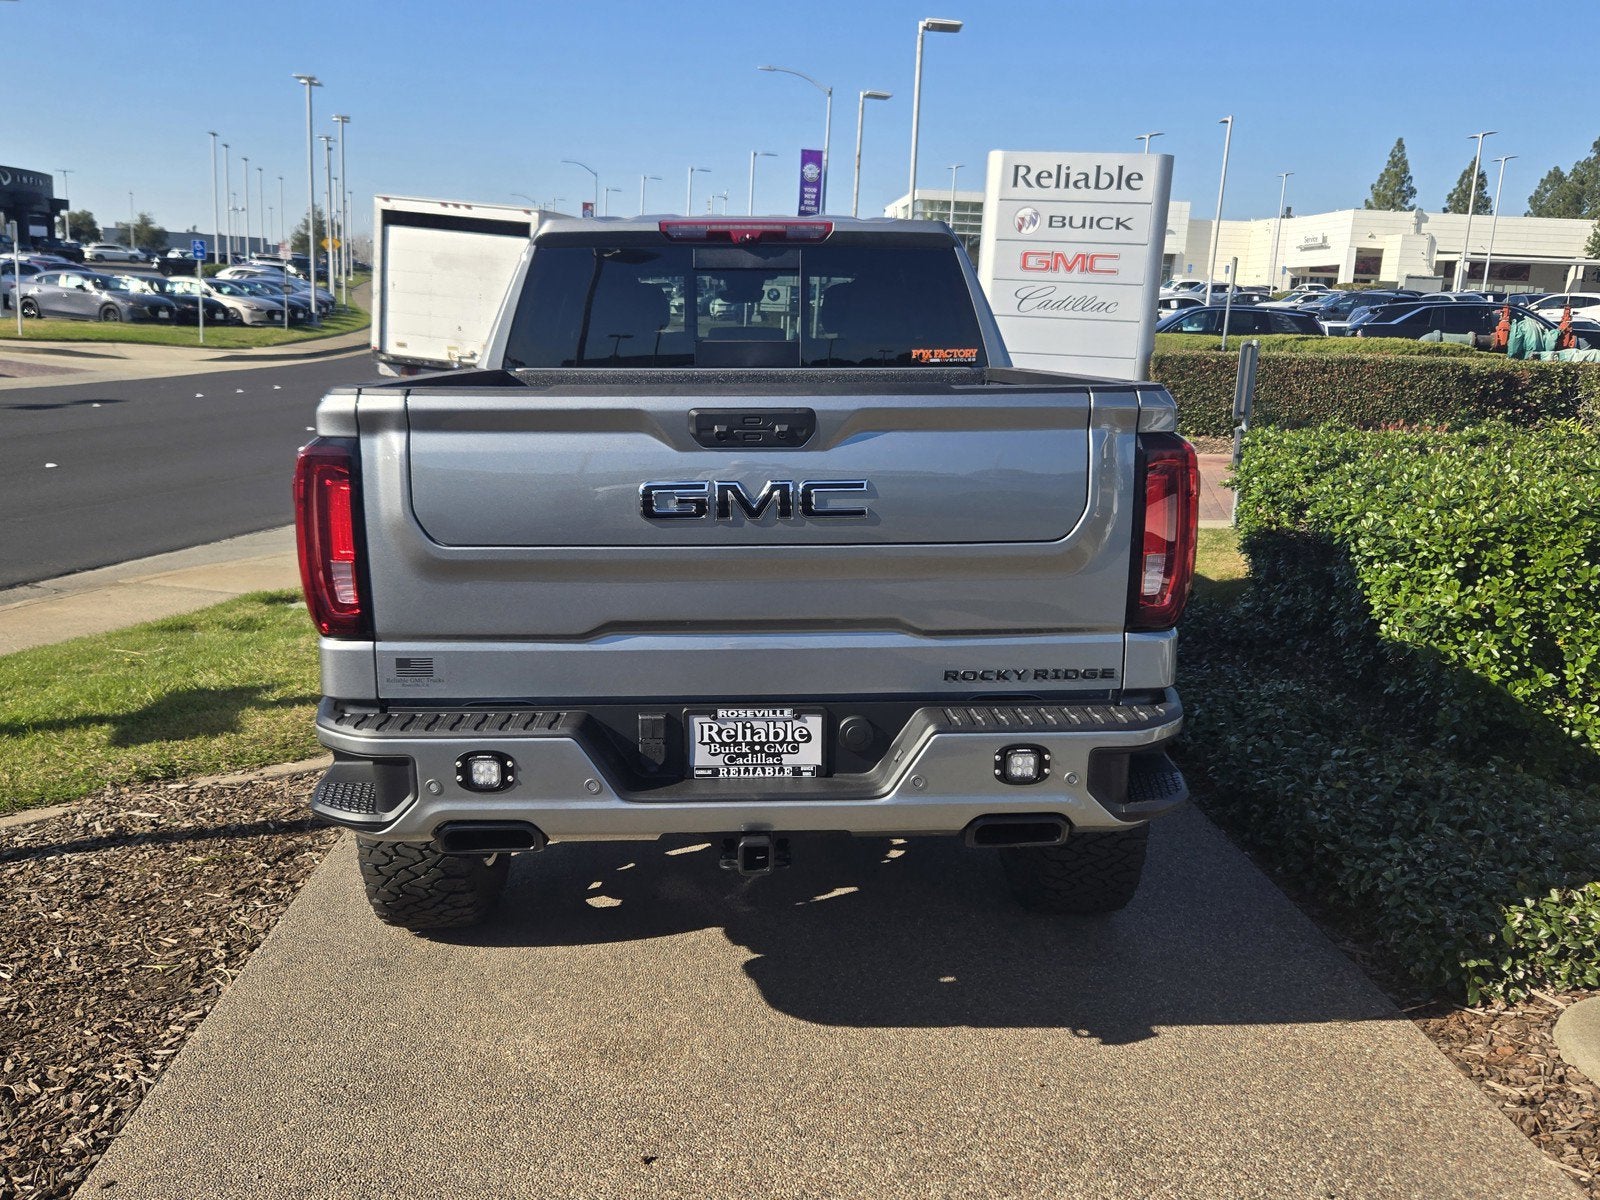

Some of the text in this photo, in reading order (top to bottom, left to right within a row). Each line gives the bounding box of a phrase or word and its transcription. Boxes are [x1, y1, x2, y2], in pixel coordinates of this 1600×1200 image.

[1011, 163, 1144, 191] Reliable
[1048, 214, 1133, 231] BUICK
[1020, 250, 1121, 275] GMC
[1014, 285, 1119, 314] Cadillac
[911, 349, 978, 361] FOX FACTORY
[638, 479, 869, 521] GMC
[943, 668, 1116, 682] ROCKY RIDGE
[718, 709, 793, 718] ROSEVILLE
[699, 720, 810, 744] Reliable
[709, 743, 799, 754] Buick GMC
[723, 753, 782, 765] Cadillac
[718, 766, 793, 777] RELIABLE
